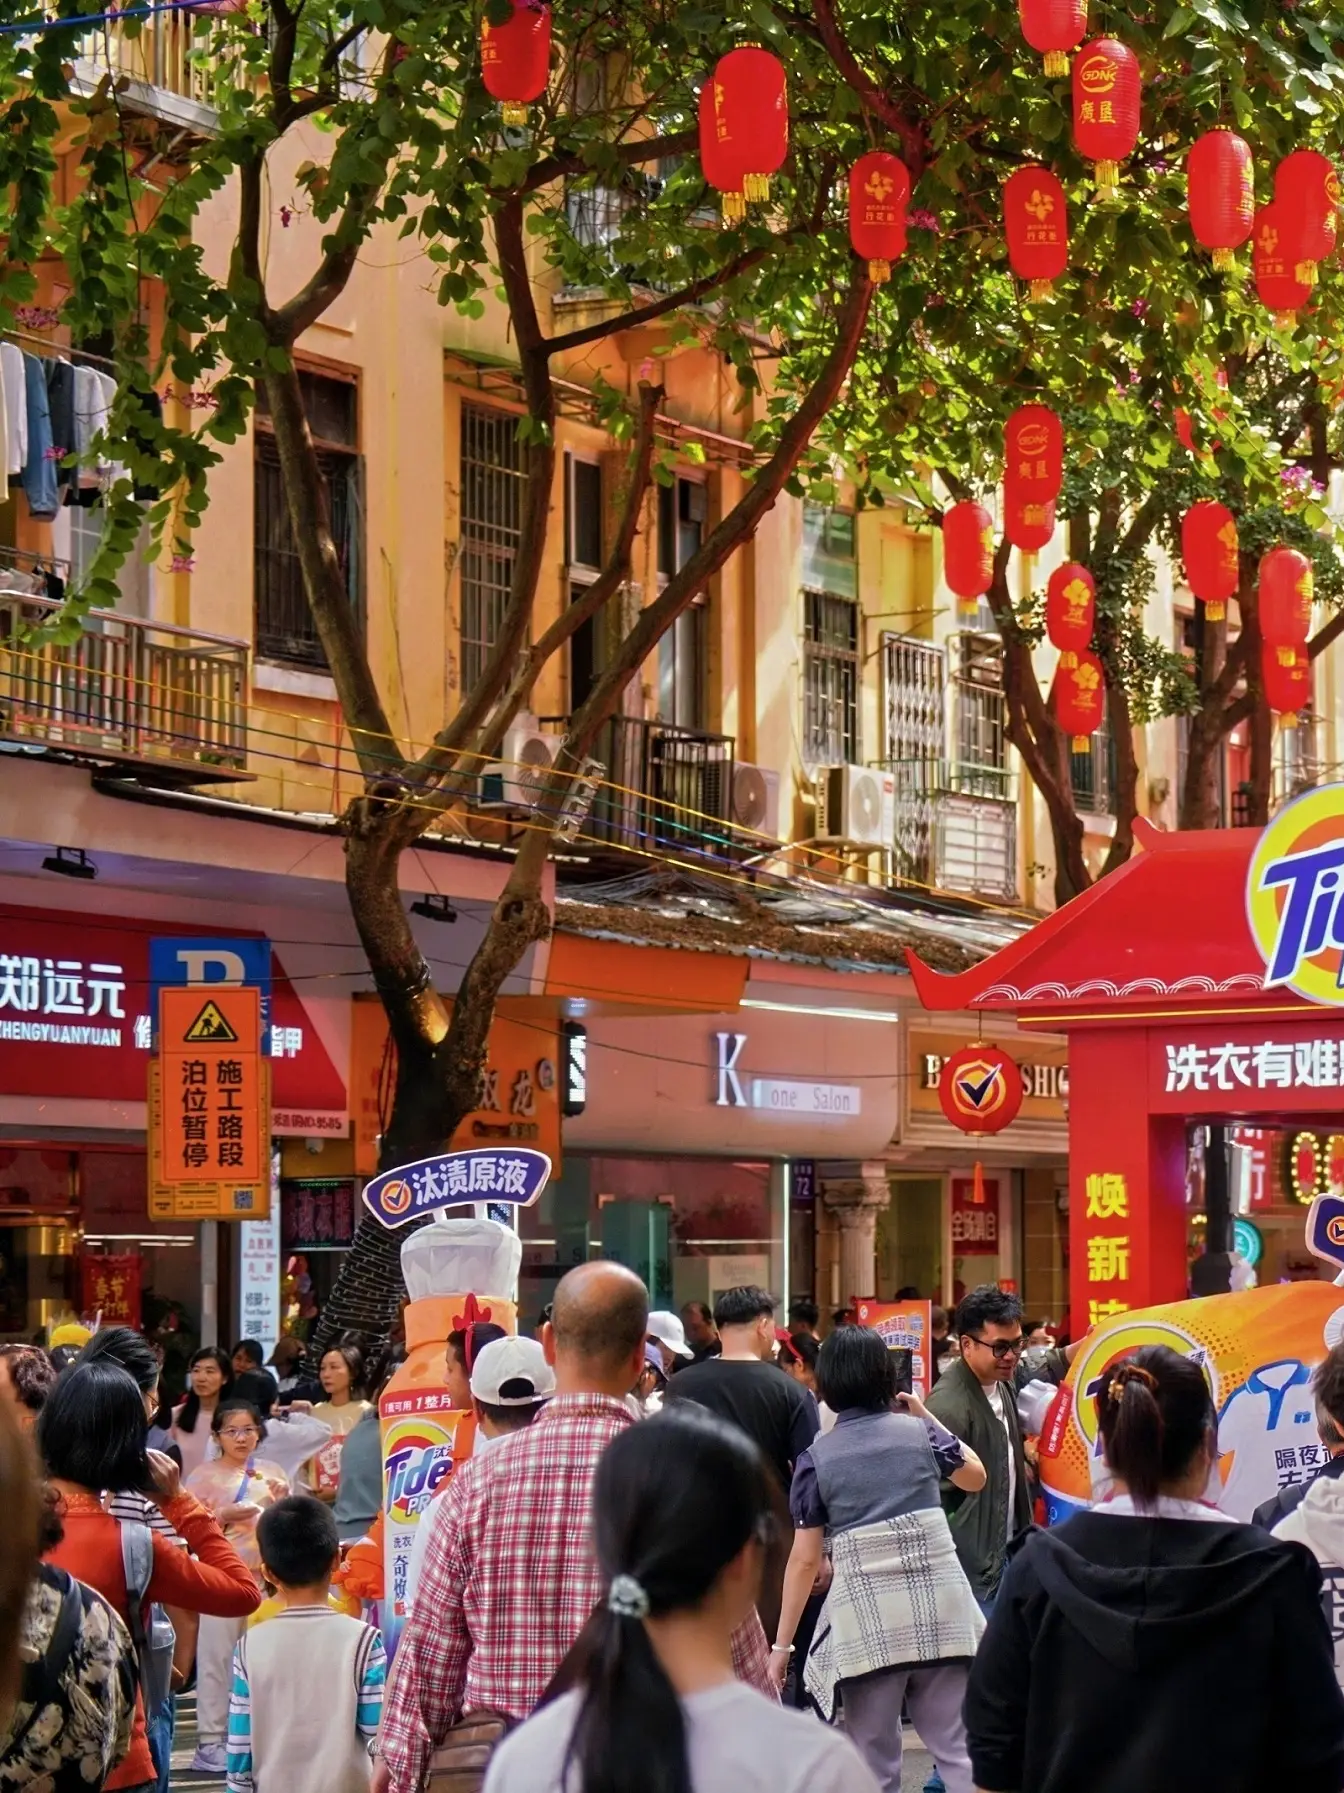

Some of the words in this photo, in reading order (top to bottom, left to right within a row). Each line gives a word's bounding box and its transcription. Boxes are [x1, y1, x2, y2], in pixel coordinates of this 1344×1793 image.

[0, 955, 125, 1018] 郑远元
[0, 1020, 121, 1047] HENGYUANYUAN
[716, 1032, 748, 1107] K
[771, 1091, 798, 1108] one
[813, 1087, 851, 1111] Salon
[181, 1060, 208, 1168] 泊位暂停
[217, 1060, 243, 1167] 施工路段
[412, 1157, 530, 1204] 汰渍原液
[416, 1394, 451, 1411] 1整月
[385, 1446, 453, 1515] Tide
[405, 1494, 432, 1517] PR
[393, 1536, 414, 1549] 洗衣
